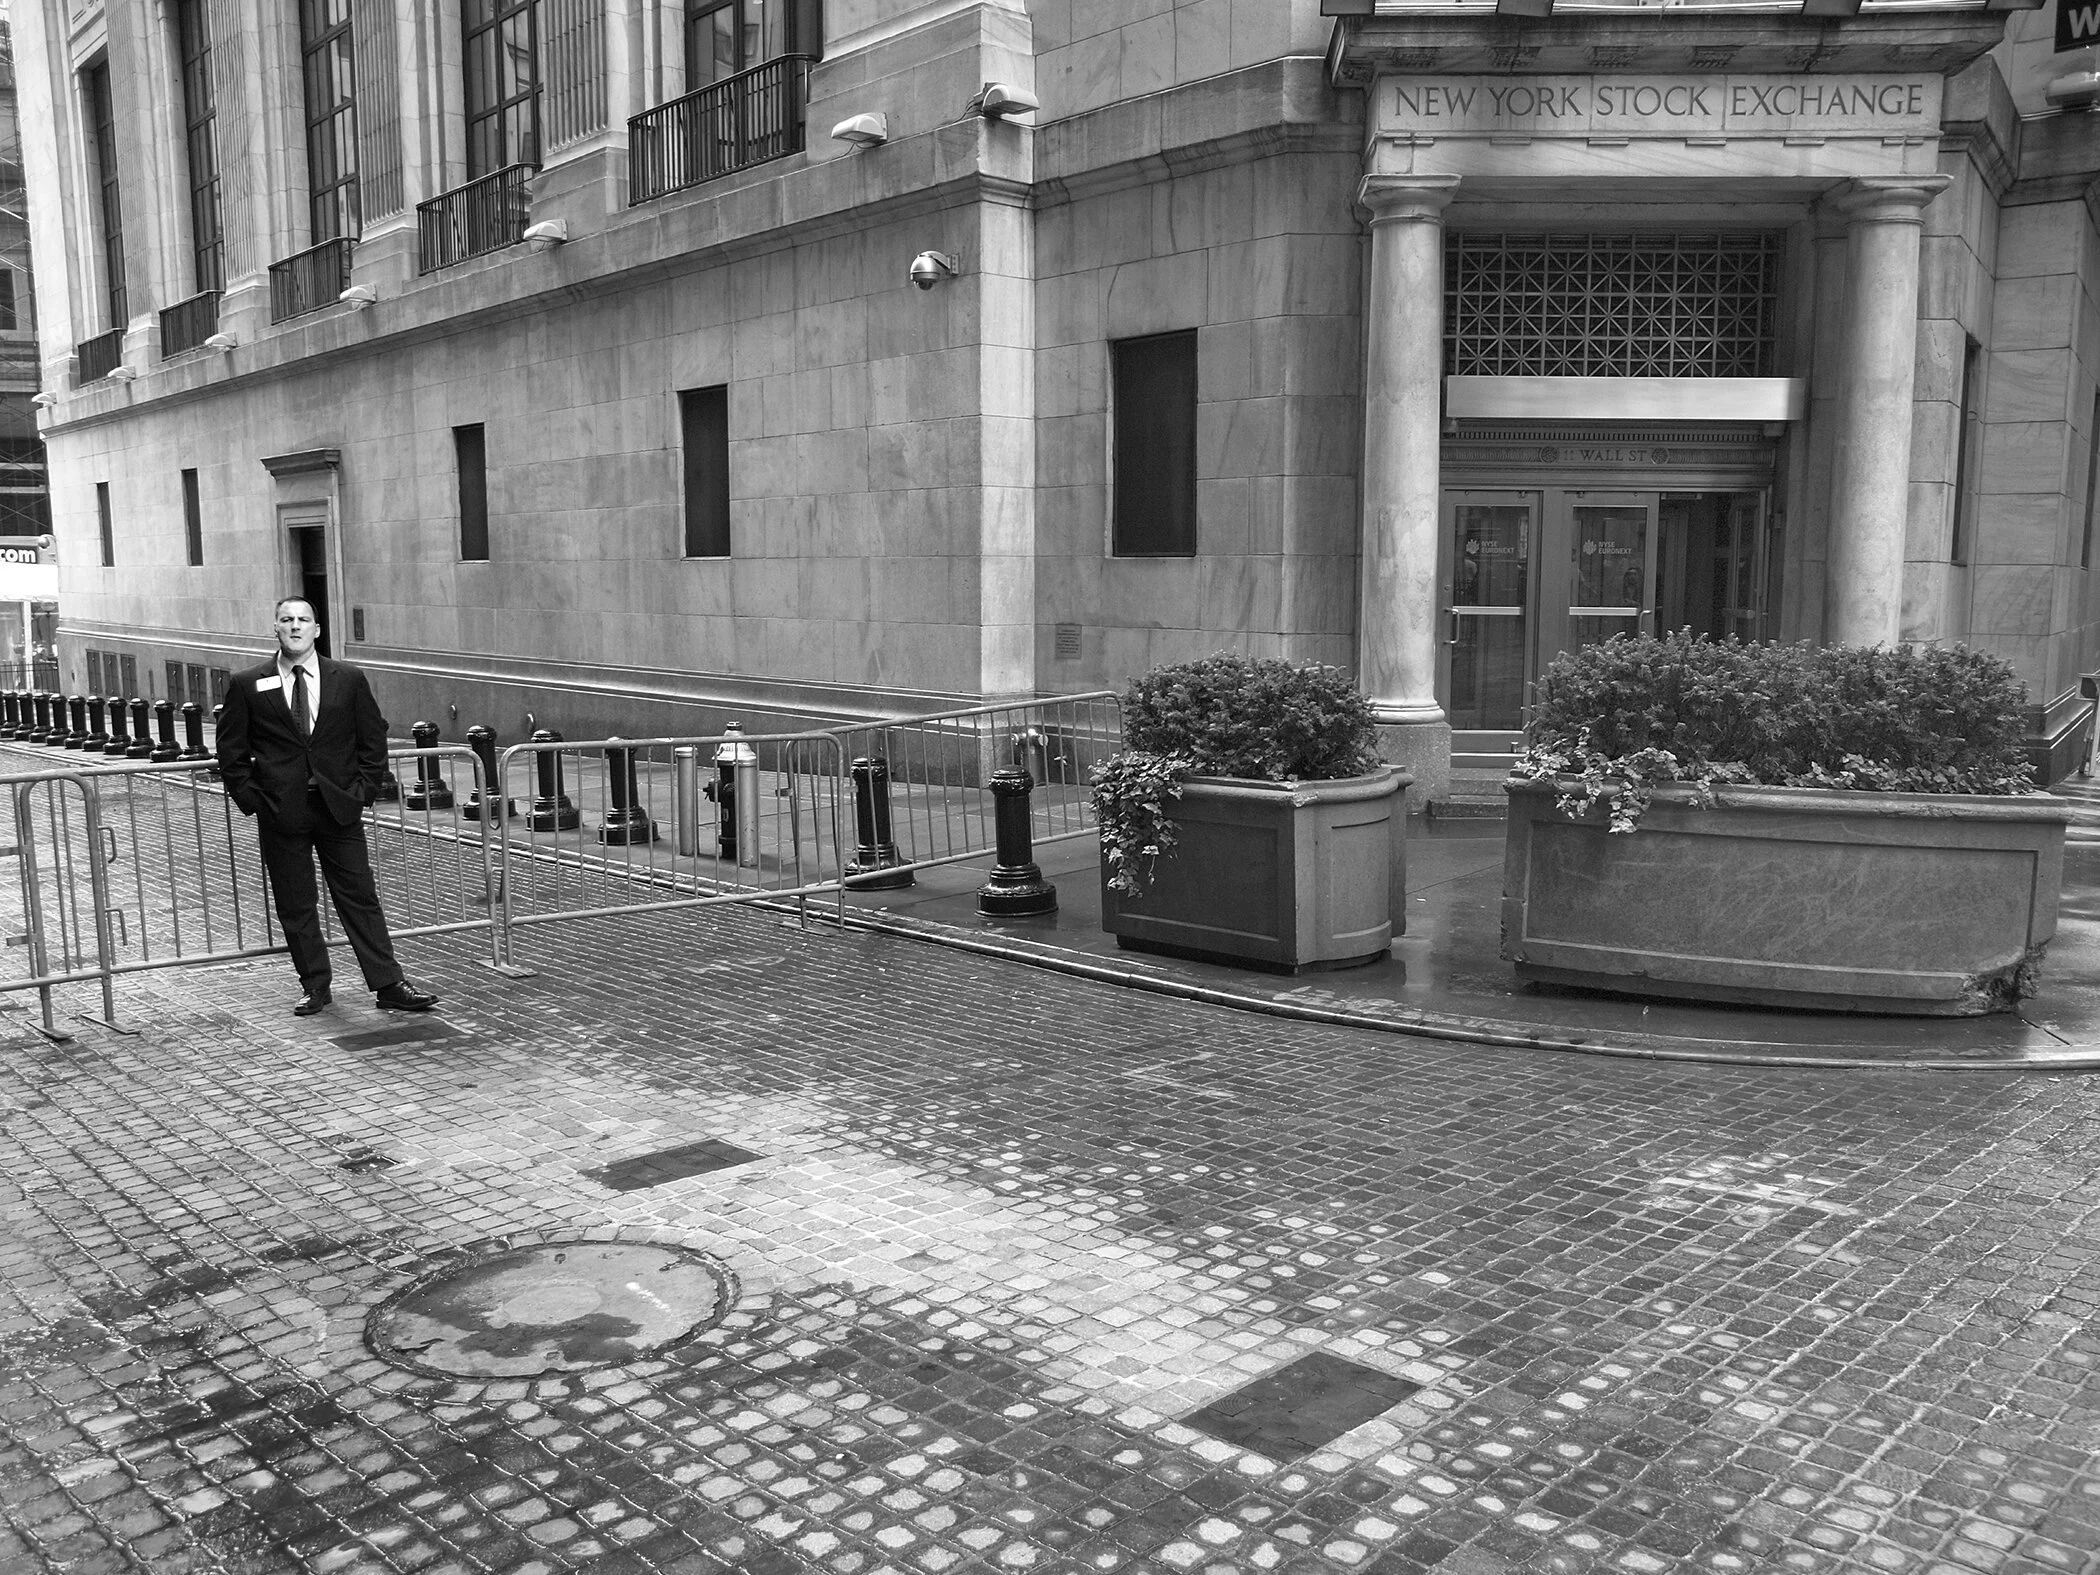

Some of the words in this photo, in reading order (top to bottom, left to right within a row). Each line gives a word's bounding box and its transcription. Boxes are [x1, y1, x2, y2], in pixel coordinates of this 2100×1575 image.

[1394, 86, 1477, 117] NEW
[1487, 86, 1584, 119] YORK
[1595, 85, 1713, 117] STOCK
[1730, 84, 1924, 117] EXCHANGE
[1580, 449, 1624, 462] WALL
[1628, 449, 1648, 462] ST
